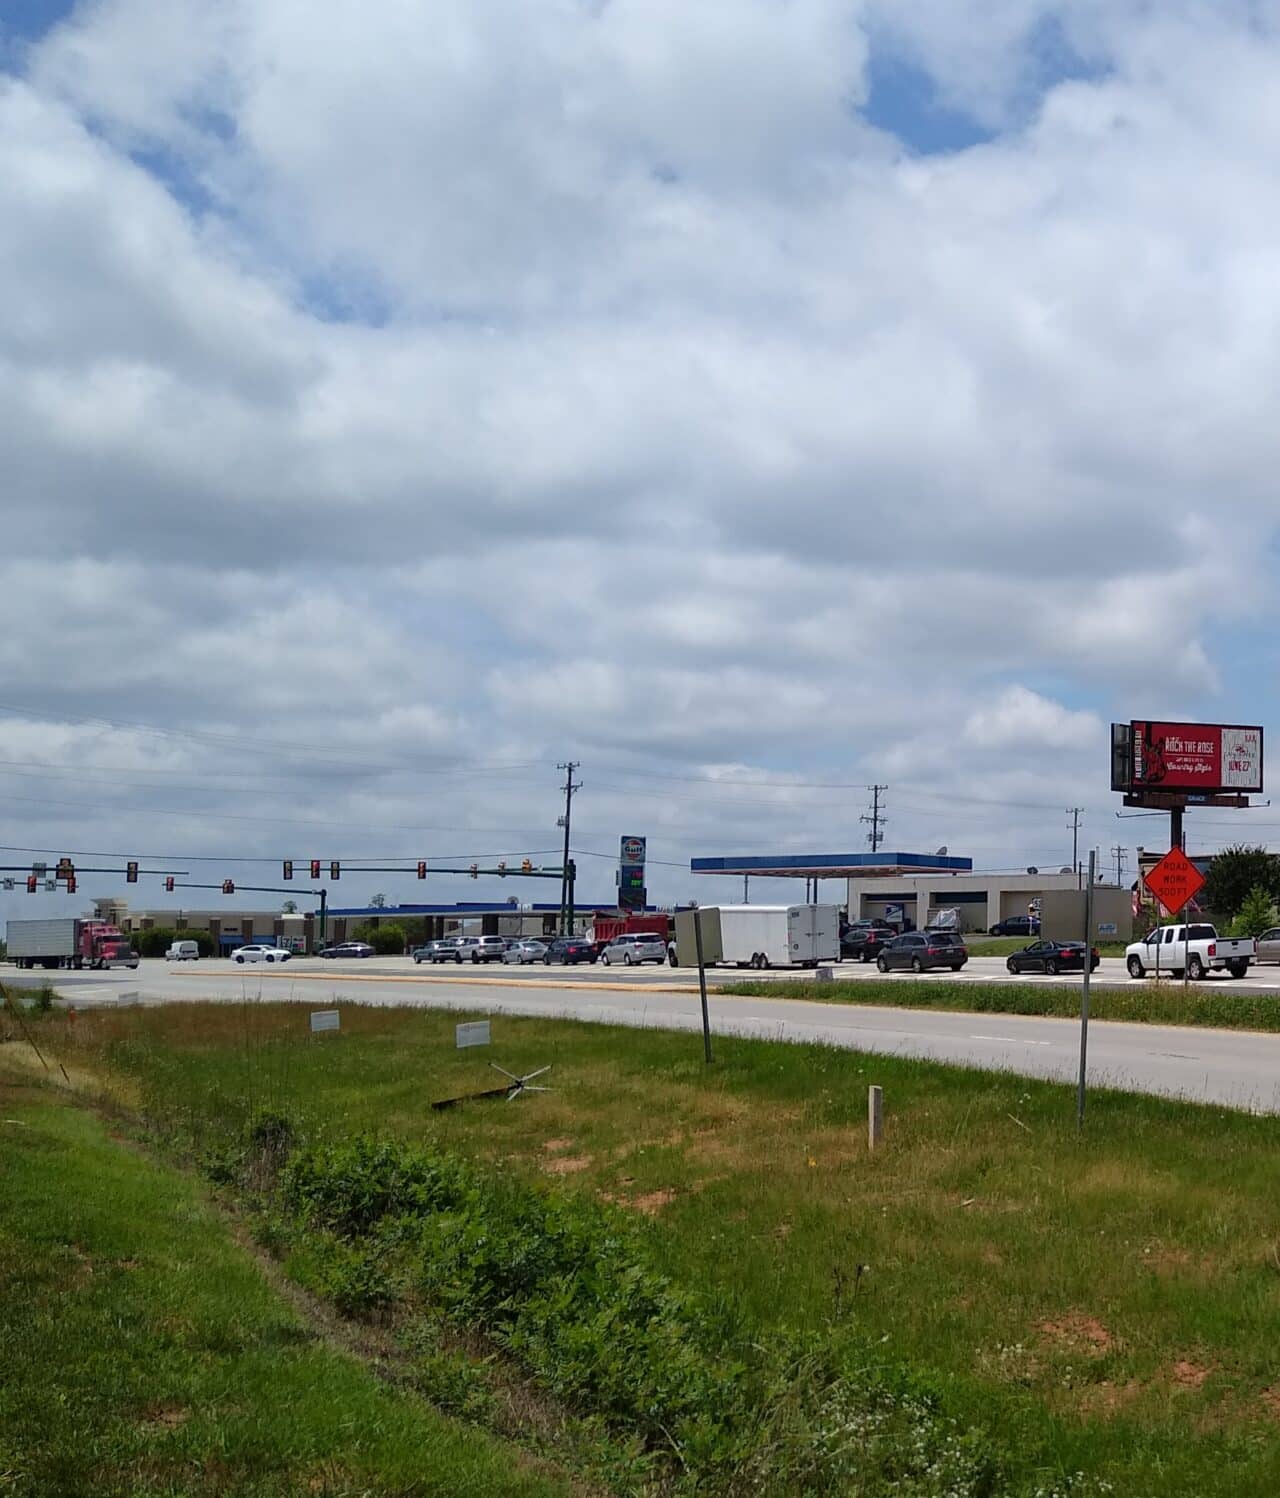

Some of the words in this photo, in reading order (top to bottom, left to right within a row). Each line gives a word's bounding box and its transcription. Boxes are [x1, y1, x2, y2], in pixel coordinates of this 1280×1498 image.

[1165, 737, 1183, 752] ROCK
[1184, 741, 1196, 752] THE
[1197, 742, 1214, 753] ROSE
[1163, 875, 1187, 883] WORK
